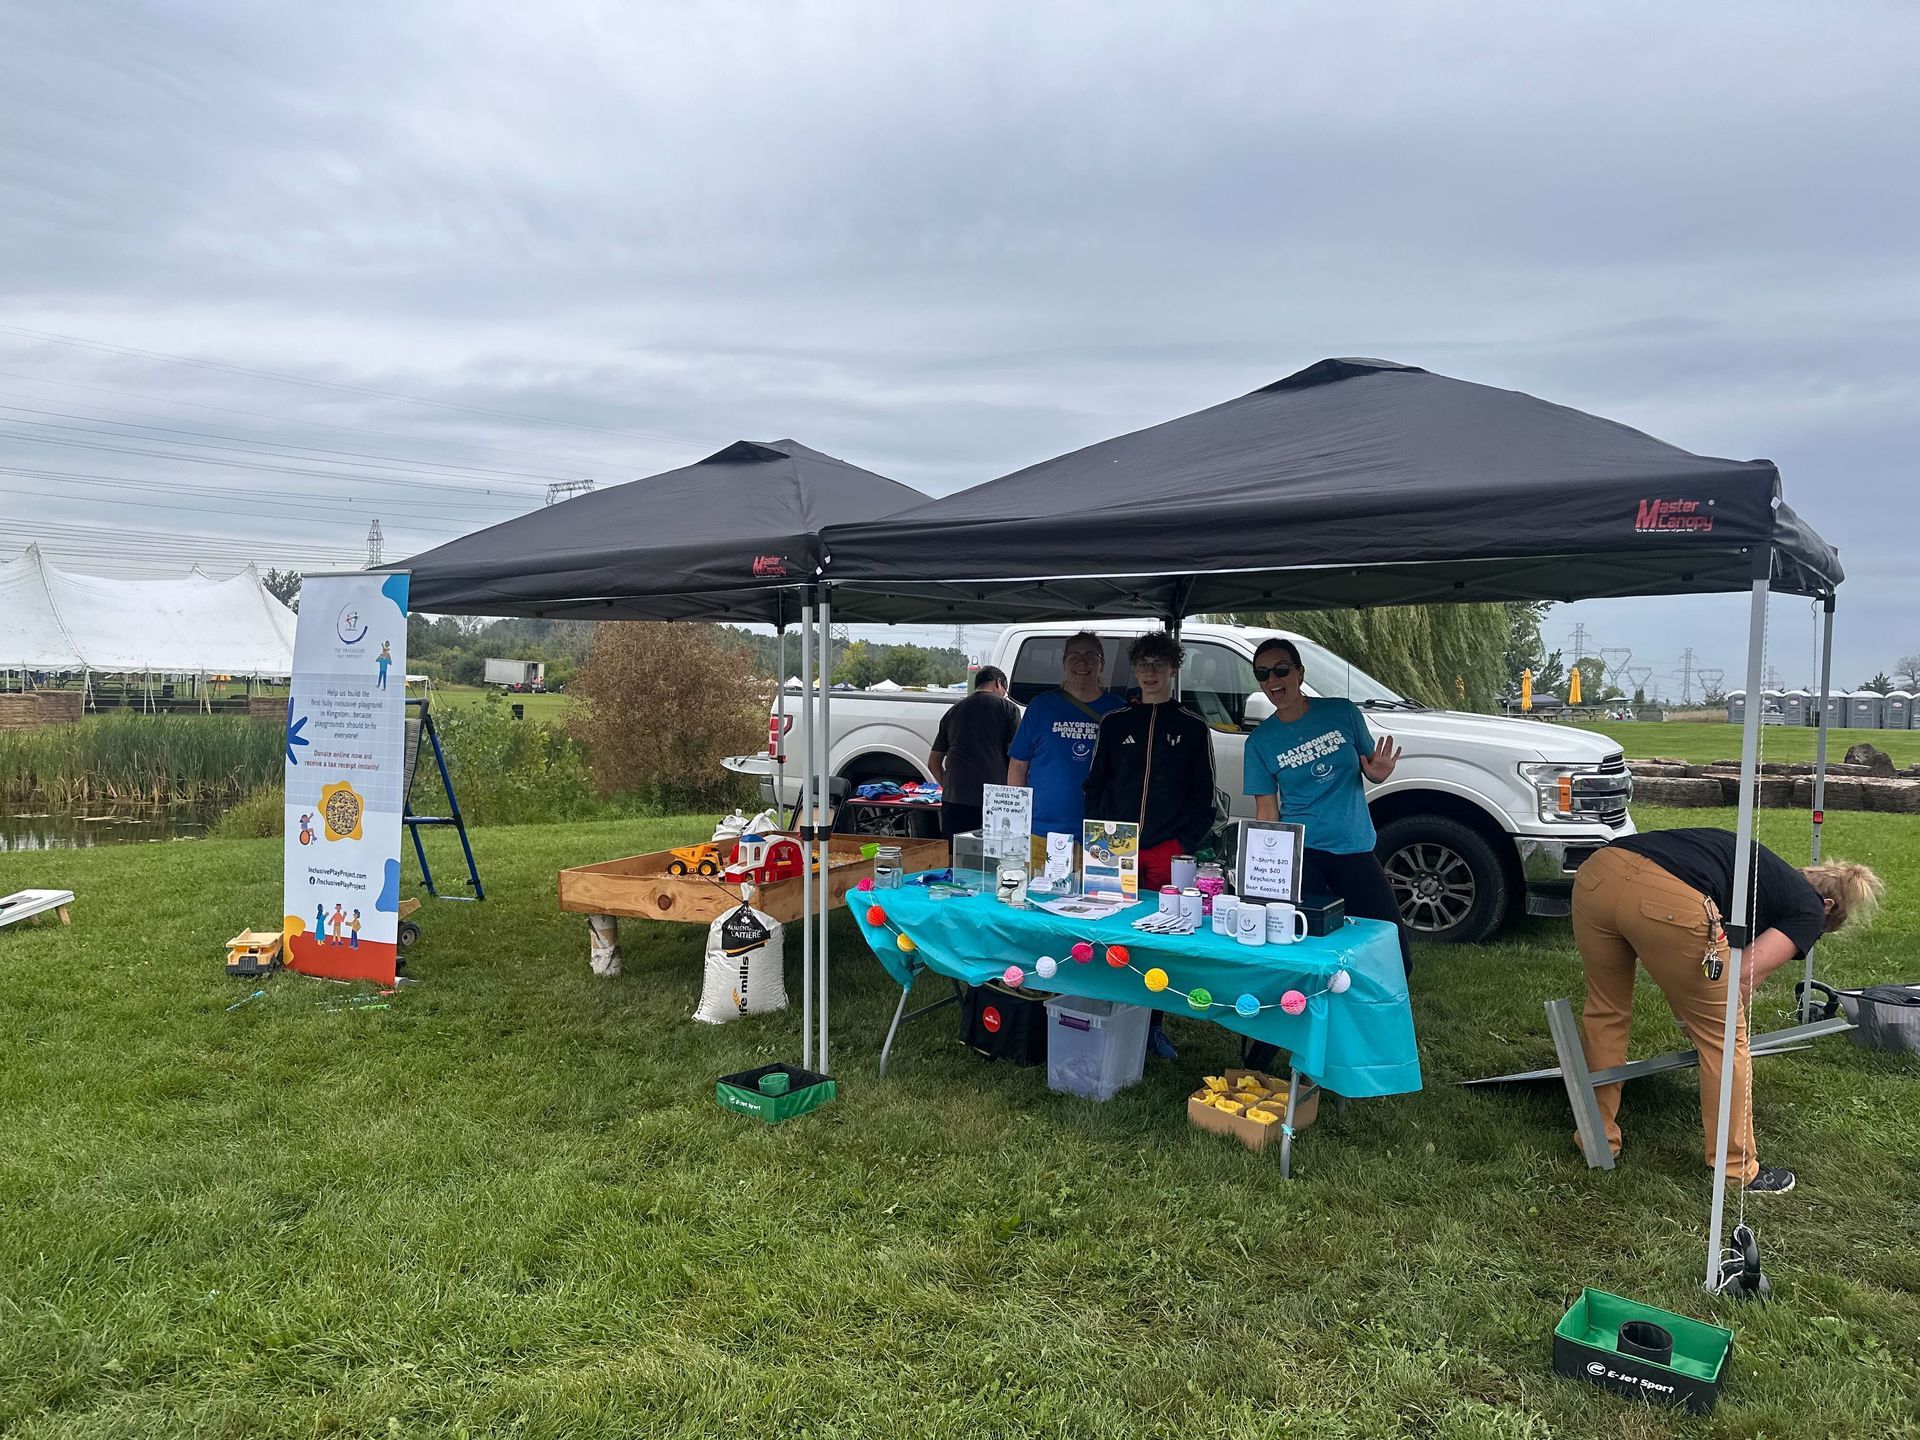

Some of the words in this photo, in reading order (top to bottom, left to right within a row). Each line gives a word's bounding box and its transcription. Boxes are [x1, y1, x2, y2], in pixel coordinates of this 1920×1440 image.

[1635, 498, 1699, 529] Master
[1657, 513, 1714, 532] Canopy
[327, 689, 338, 697] Help
[311, 698, 321, 706] first
[322, 699, 333, 708] fully
[358, 701, 383, 710] playground
[315, 720, 345, 729] playgrounds
[346, 721, 363, 729] should
[334, 732, 359, 740] everyone!
[1276, 730, 1342, 762] PLAYGROUNDS
[1278, 749, 1314, 769] SHOULD
[1315, 742, 1327, 752] BE
[1328, 736, 1347, 746] FOR
[314, 750, 332, 758] Donate
[333, 751, 350, 759] online
[1290, 744, 1340, 769] EVERYONE
[338, 762, 357, 770] receipt
[358, 763, 380, 771] instantly!
[1251, 856, 1275, 864] T-Shirts
[308, 866, 367, 879] InclusivePlayProject.com
[1250, 875, 1276, 883] Keychains
[316, 877, 366, 890] /InclusivePlayProject
[739, 956, 750, 994] mills
[1607, 1369, 1638, 1384] E-Jet
[1640, 1378, 1675, 1394] Sport
